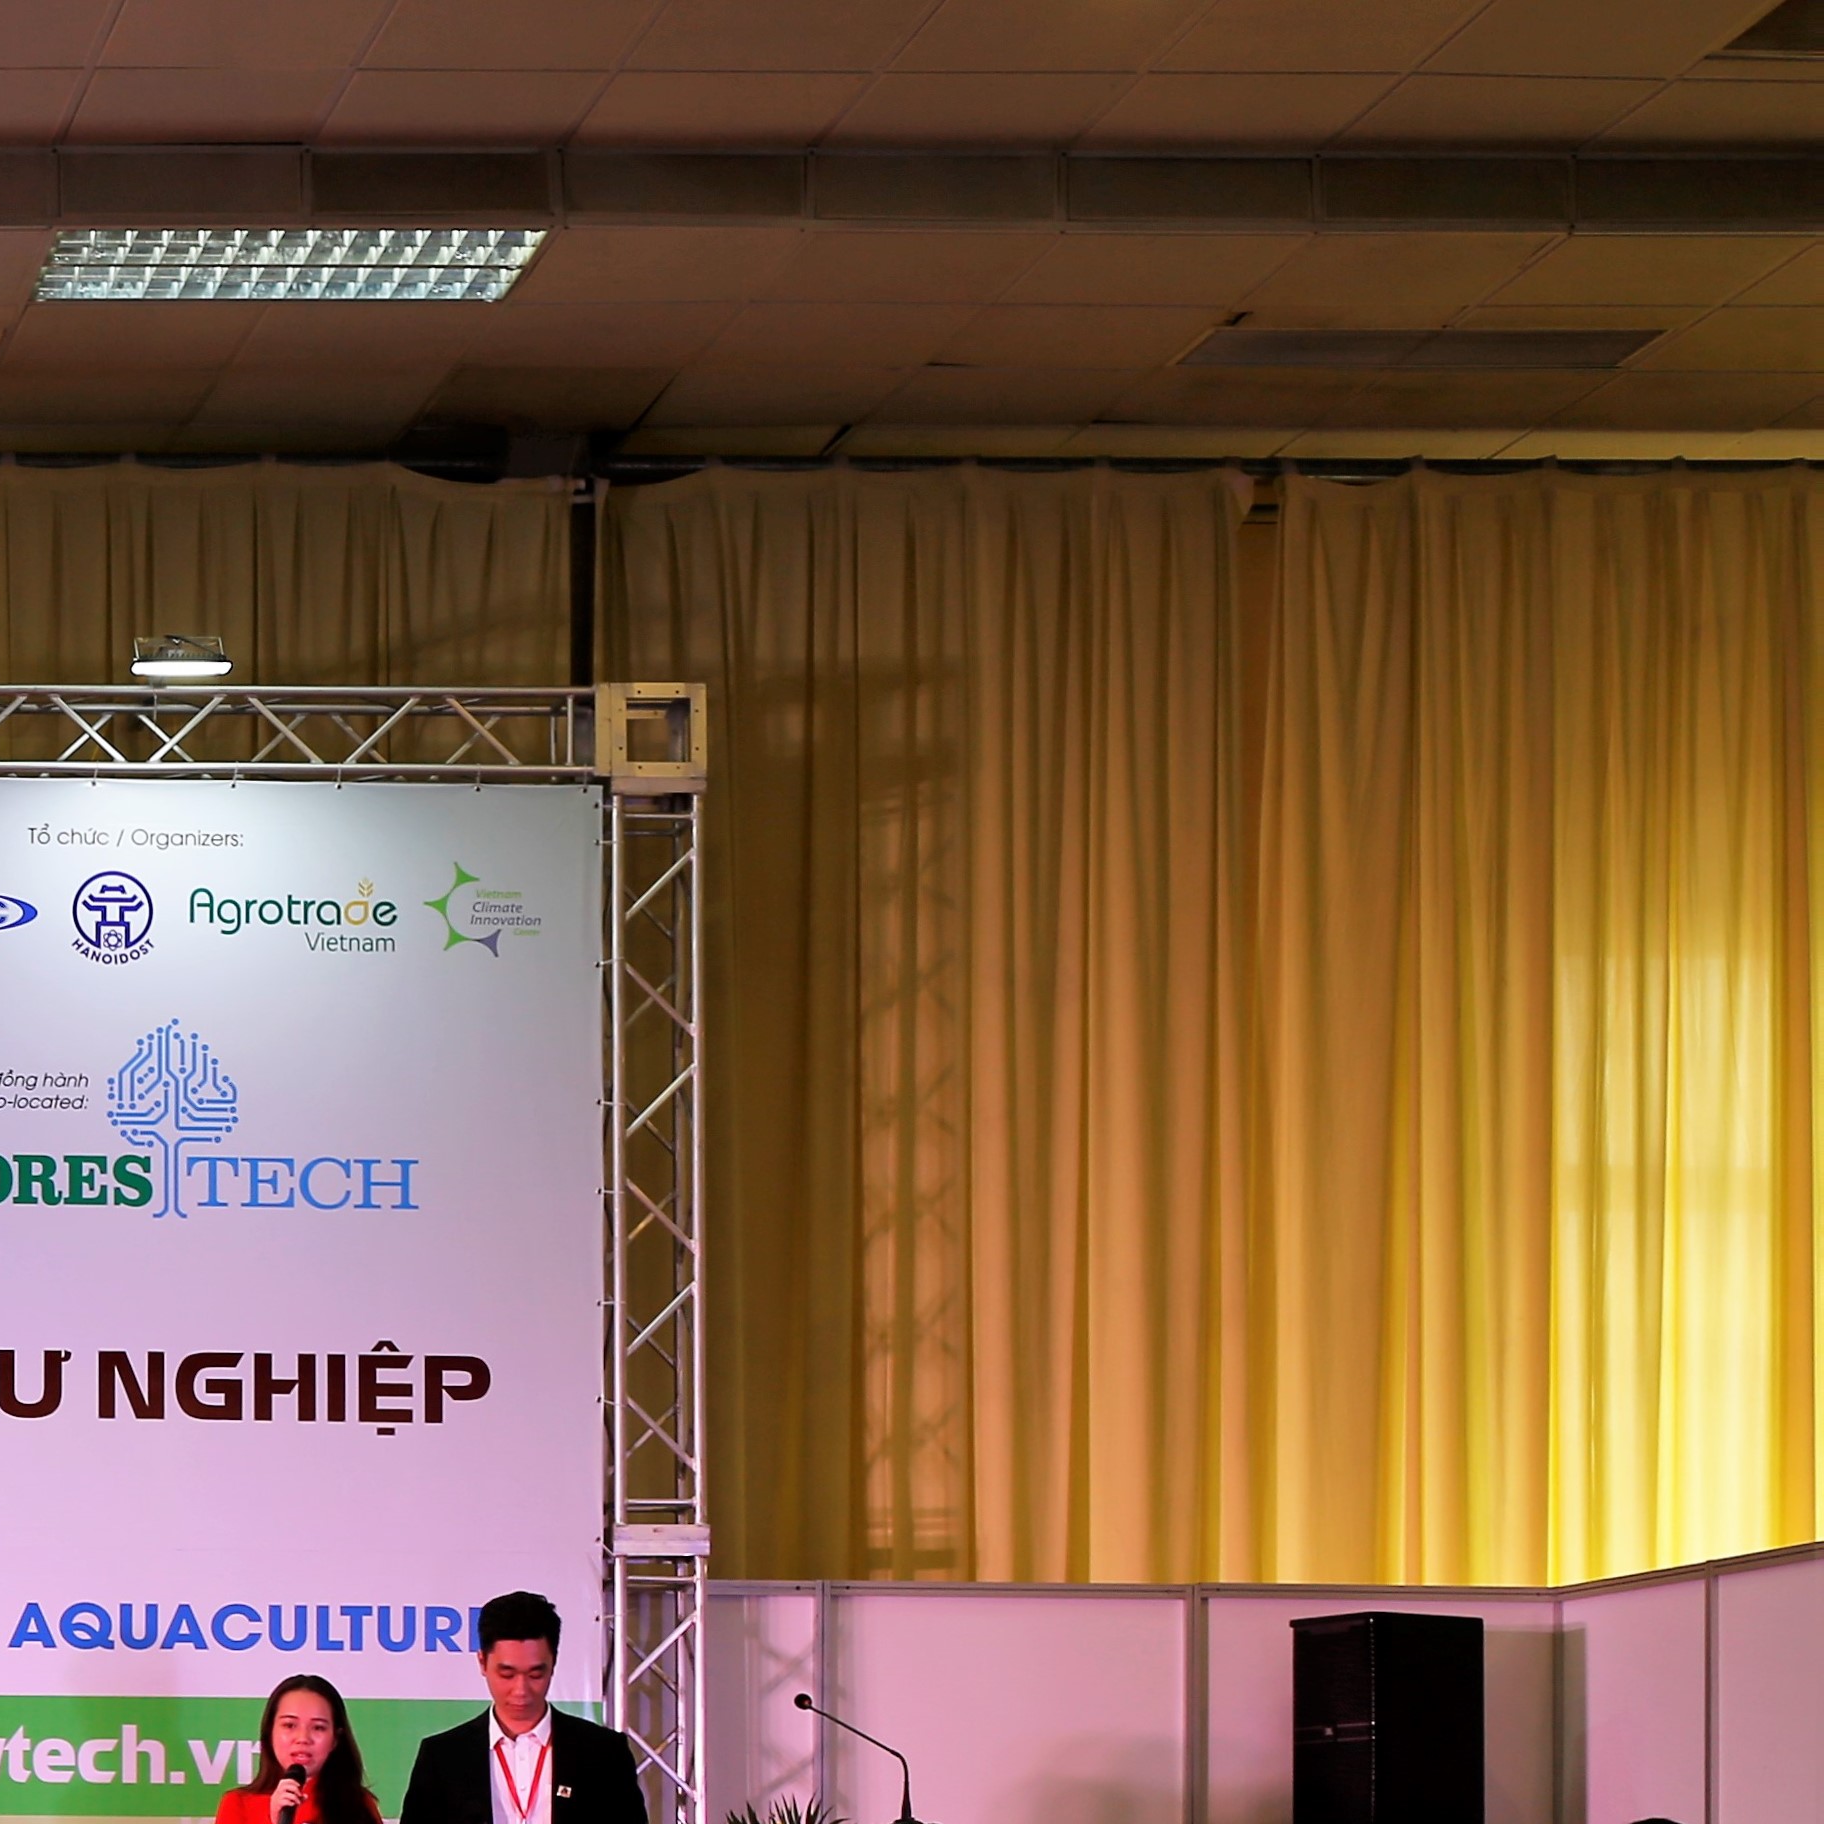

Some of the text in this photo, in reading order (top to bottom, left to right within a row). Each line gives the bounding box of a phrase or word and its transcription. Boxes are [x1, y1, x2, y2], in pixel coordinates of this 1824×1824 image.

[27, 823, 244, 851] Tổ chức / Organizers:
[188, 886, 399, 936] Agrotrade
[472, 901, 524, 914] Climate
[470, 914, 542, 926] Innovation
[71, 938, 155, 965] HANOIDOST
[304, 932, 396, 953] Vietnam
[42, 1071, 90, 1088] hành
[97, 1340, 492, 1436] NGHIỆP
